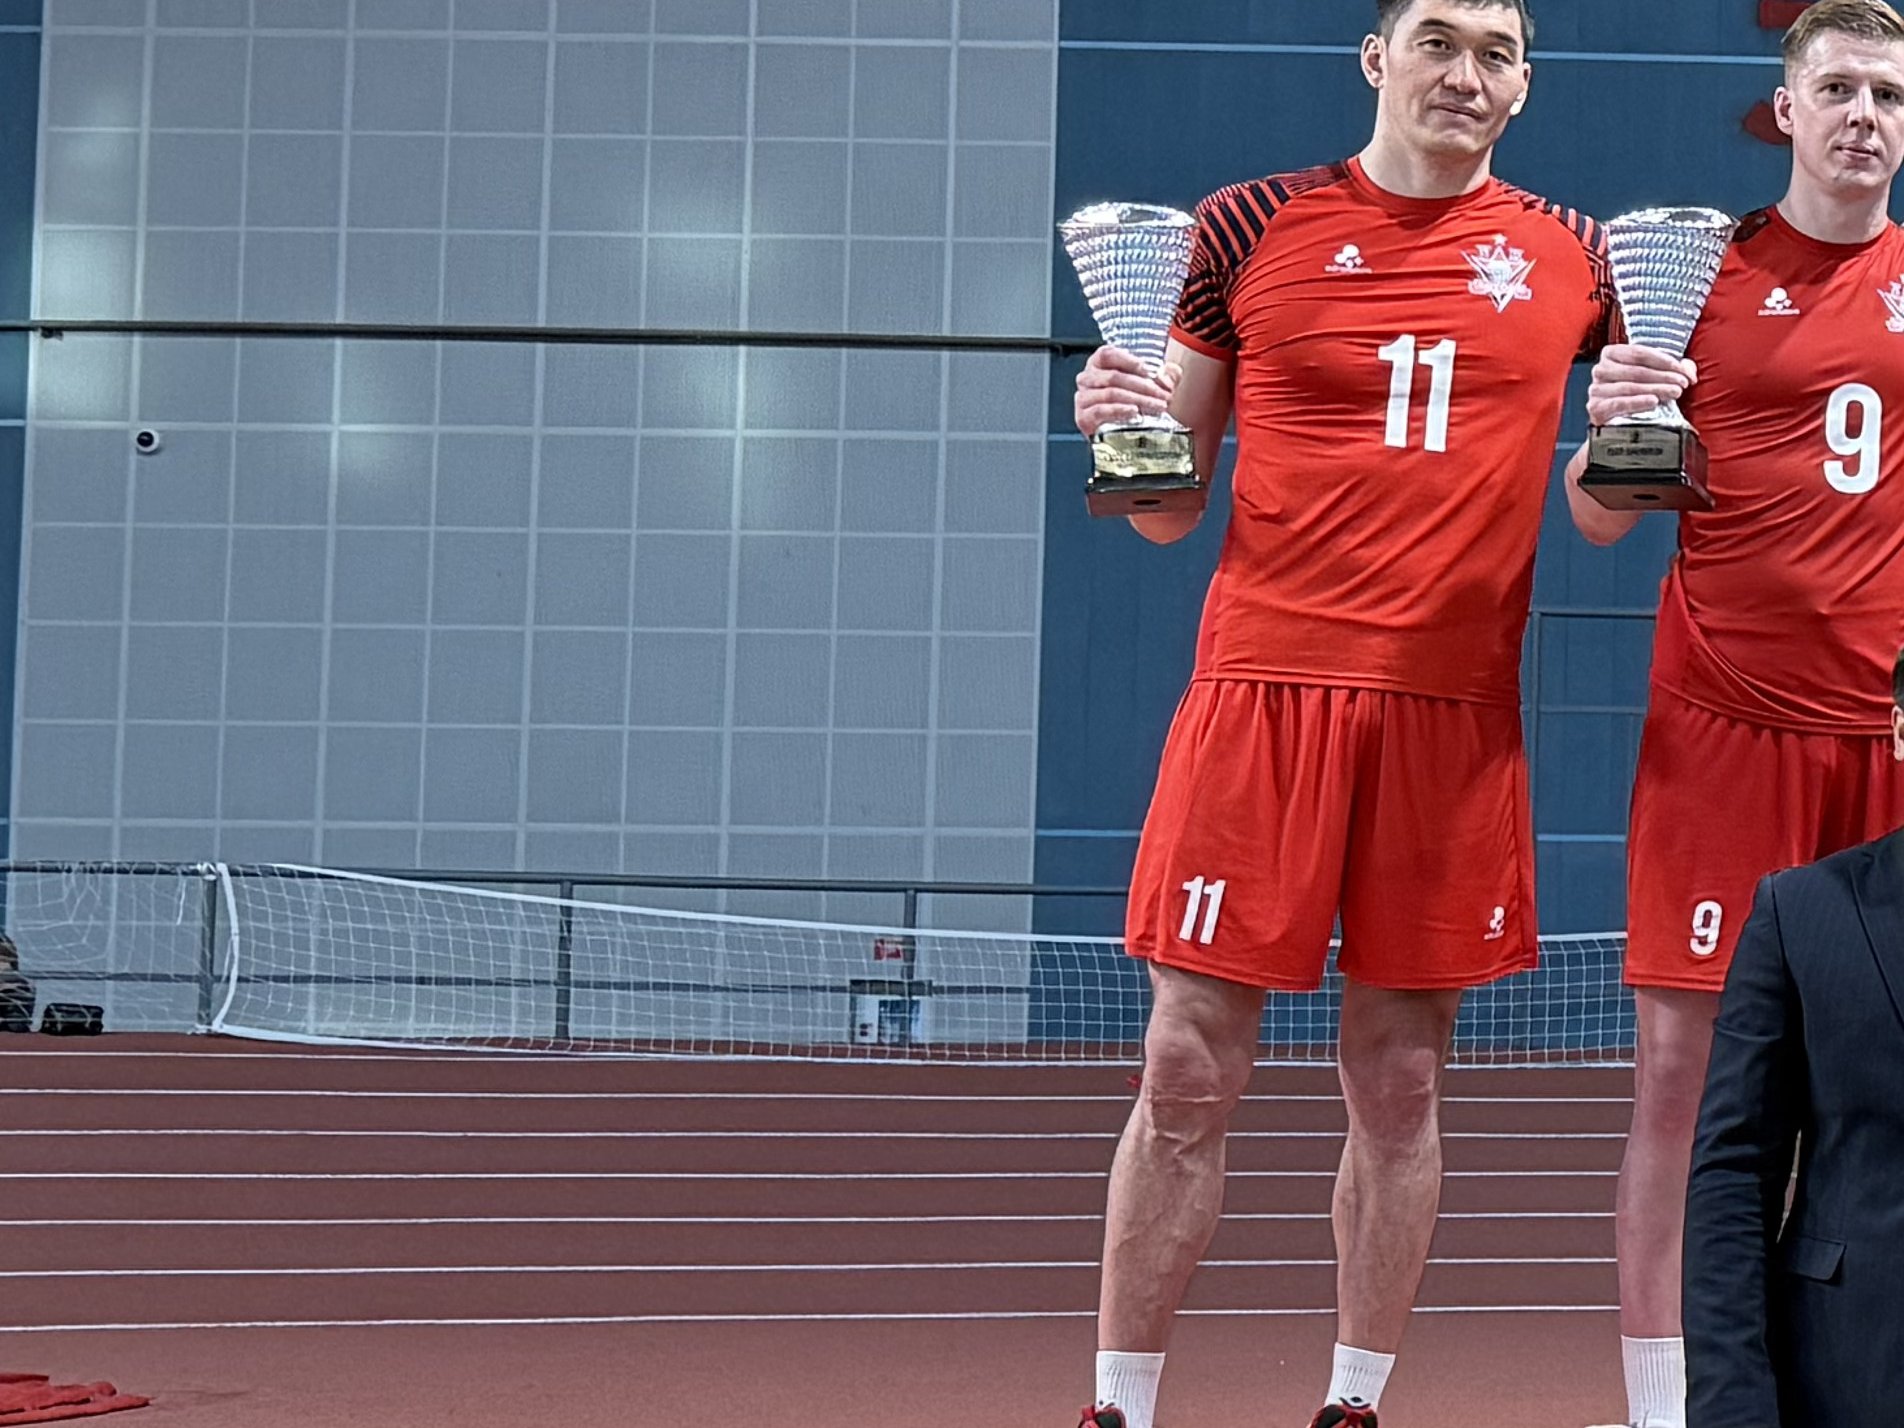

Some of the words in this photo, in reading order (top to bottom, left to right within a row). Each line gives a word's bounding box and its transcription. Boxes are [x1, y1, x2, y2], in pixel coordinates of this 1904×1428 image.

[1378, 333, 1457, 452] 11
[1823, 383, 1883, 494] 9
[1179, 875, 1227, 945] 11
[1690, 900, 1723, 956] 9
